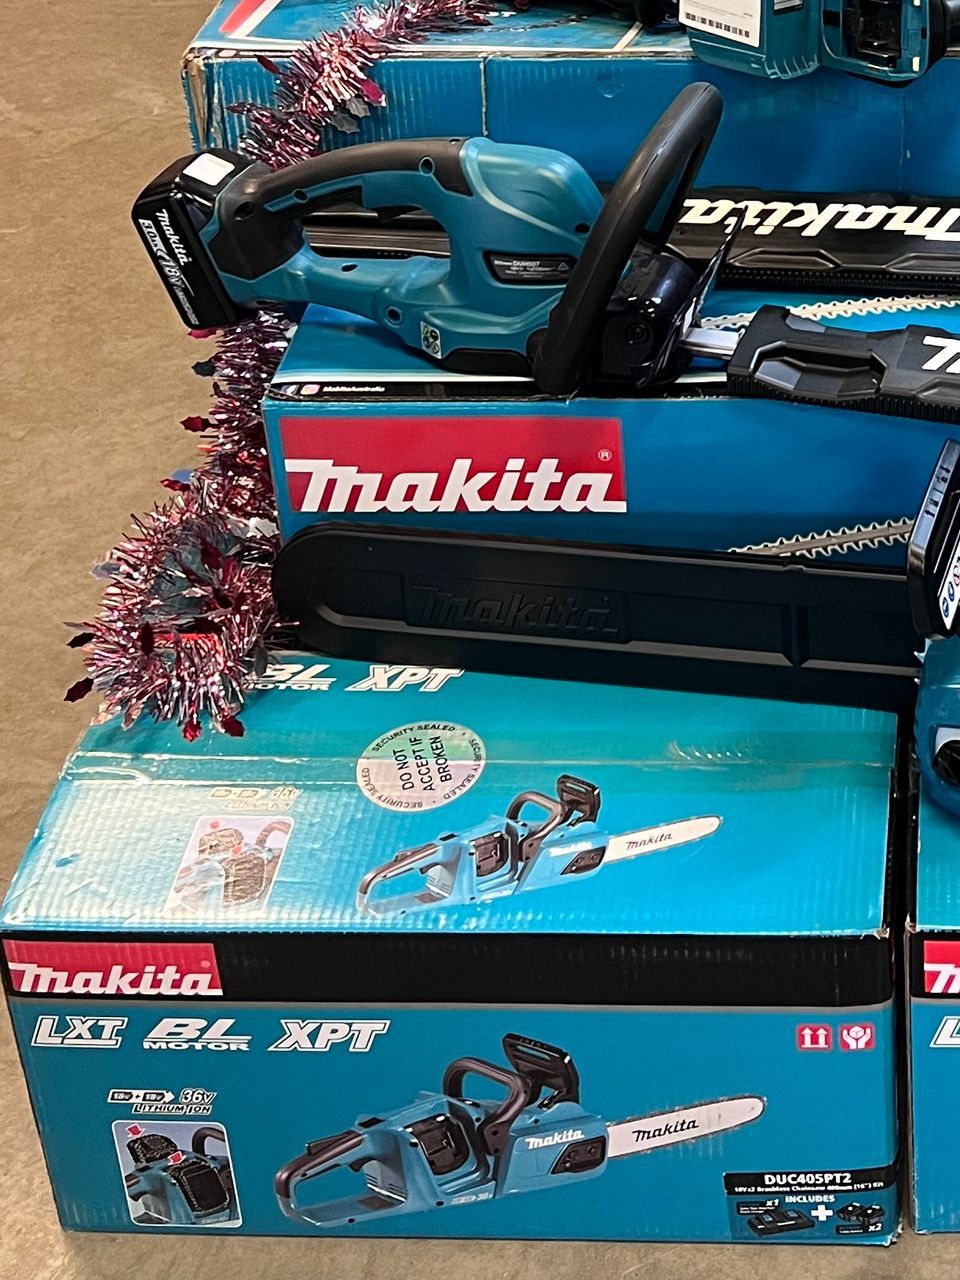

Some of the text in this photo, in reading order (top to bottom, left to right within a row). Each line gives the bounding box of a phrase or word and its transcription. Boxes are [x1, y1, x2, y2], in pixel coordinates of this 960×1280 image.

[284, 457, 628, 514] makita
[344, 664, 465, 692] XPT
[371, 723, 456, 752] SECURITY SEALED
[393, 749, 415, 791] DO NOT
[409, 736, 436, 791] ACCEPT IF
[430, 735, 453, 783] BROKEN
[8, 962, 224, 996] makita
[31, 1015, 391, 1052] LXT BL XPT
[142, 1040, 251, 1051] MOTOR
[632, 1118, 700, 1143] makita
[764, 1172, 852, 1186] DUC405PT2
[784, 1194, 836, 1204] INCLUDES
